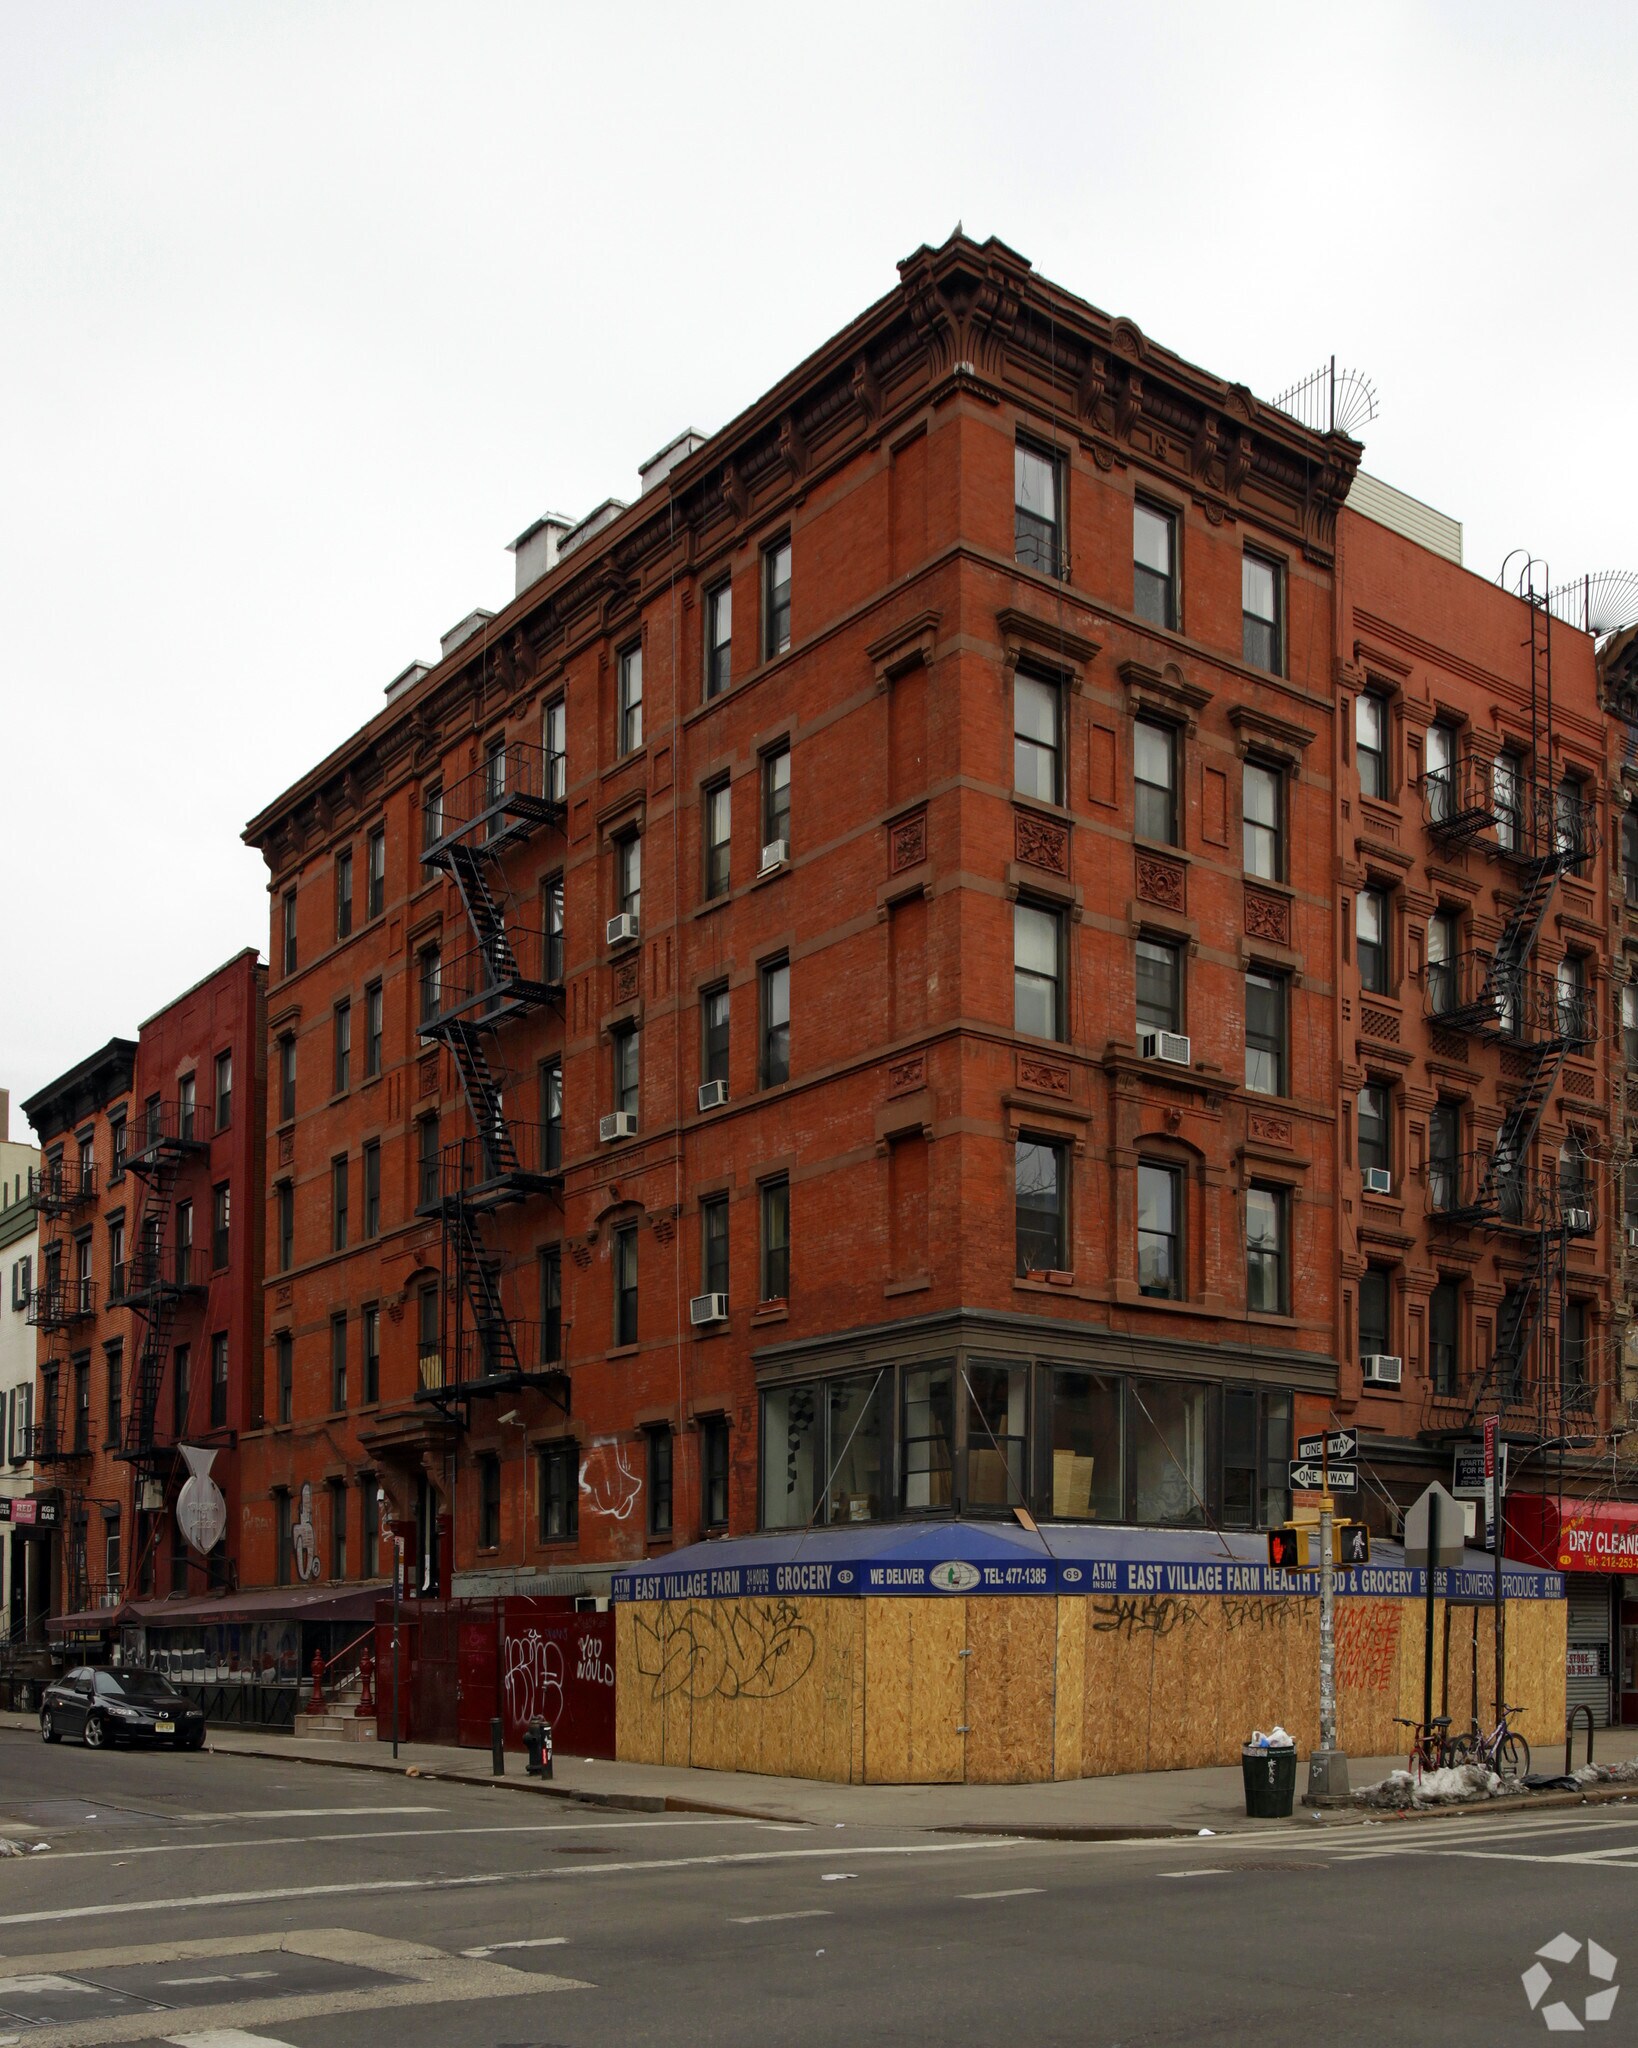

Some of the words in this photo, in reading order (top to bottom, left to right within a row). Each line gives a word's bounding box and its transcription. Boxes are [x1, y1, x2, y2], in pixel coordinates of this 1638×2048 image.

[1305, 1443, 1322, 1456] ONE
[1331, 1438, 1350, 1452] WAY
[1299, 1470, 1318, 1482] ONE
[1330, 1472, 1350, 1484] WAY
[1461, 1466, 1477, 1474] FOR
[16, 1504, 32, 1512] RED
[41, 1505, 55, 1513] KGB
[1569, 1530, 1594, 1552] DRY
[1584, 1555, 1599, 1567] Tel:
[752, 1568, 769, 1585] HOURS
[776, 1564, 833, 1591] GROCERY
[839, 1571, 851, 1581] 69
[870, 1568, 885, 1585] WE
[886, 1568, 925, 1585] DELIVER
[983, 1567, 1004, 1585] TEL:
[1005, 1567, 1047, 1585] 477-1385
[1066, 1570, 1080, 1580] 69
[1092, 1562, 1117, 1580] ATM
[1127, 1564, 1163, 1591] EAST
[1166, 1565, 1223, 1591] VILLAGE
[1226, 1566, 1260, 1591] FARM
[1263, 1567, 1311, 1592] HEALTH
[1314, 1570, 1346, 1592] FOD
[1349, 1570, 1359, 1592] &
[1361, 1569, 1413, 1593] GROCERY
[614, 1578, 630, 1594] ATM
[635, 1577, 661, 1600] EAST
[664, 1573, 708, 1599] VILLAGE
[711, 1570, 740, 1595] FARM
[746, 1584, 769, 1593] OPEN
[1092, 1580, 1117, 1589] INSIDE
[1455, 1572, 1494, 1596] FLOWERS
[1501, 1575, 1539, 1598] PRODUCE
[1544, 1576, 1561, 1591] ATM
[577, 1659, 615, 1687] WOULD
